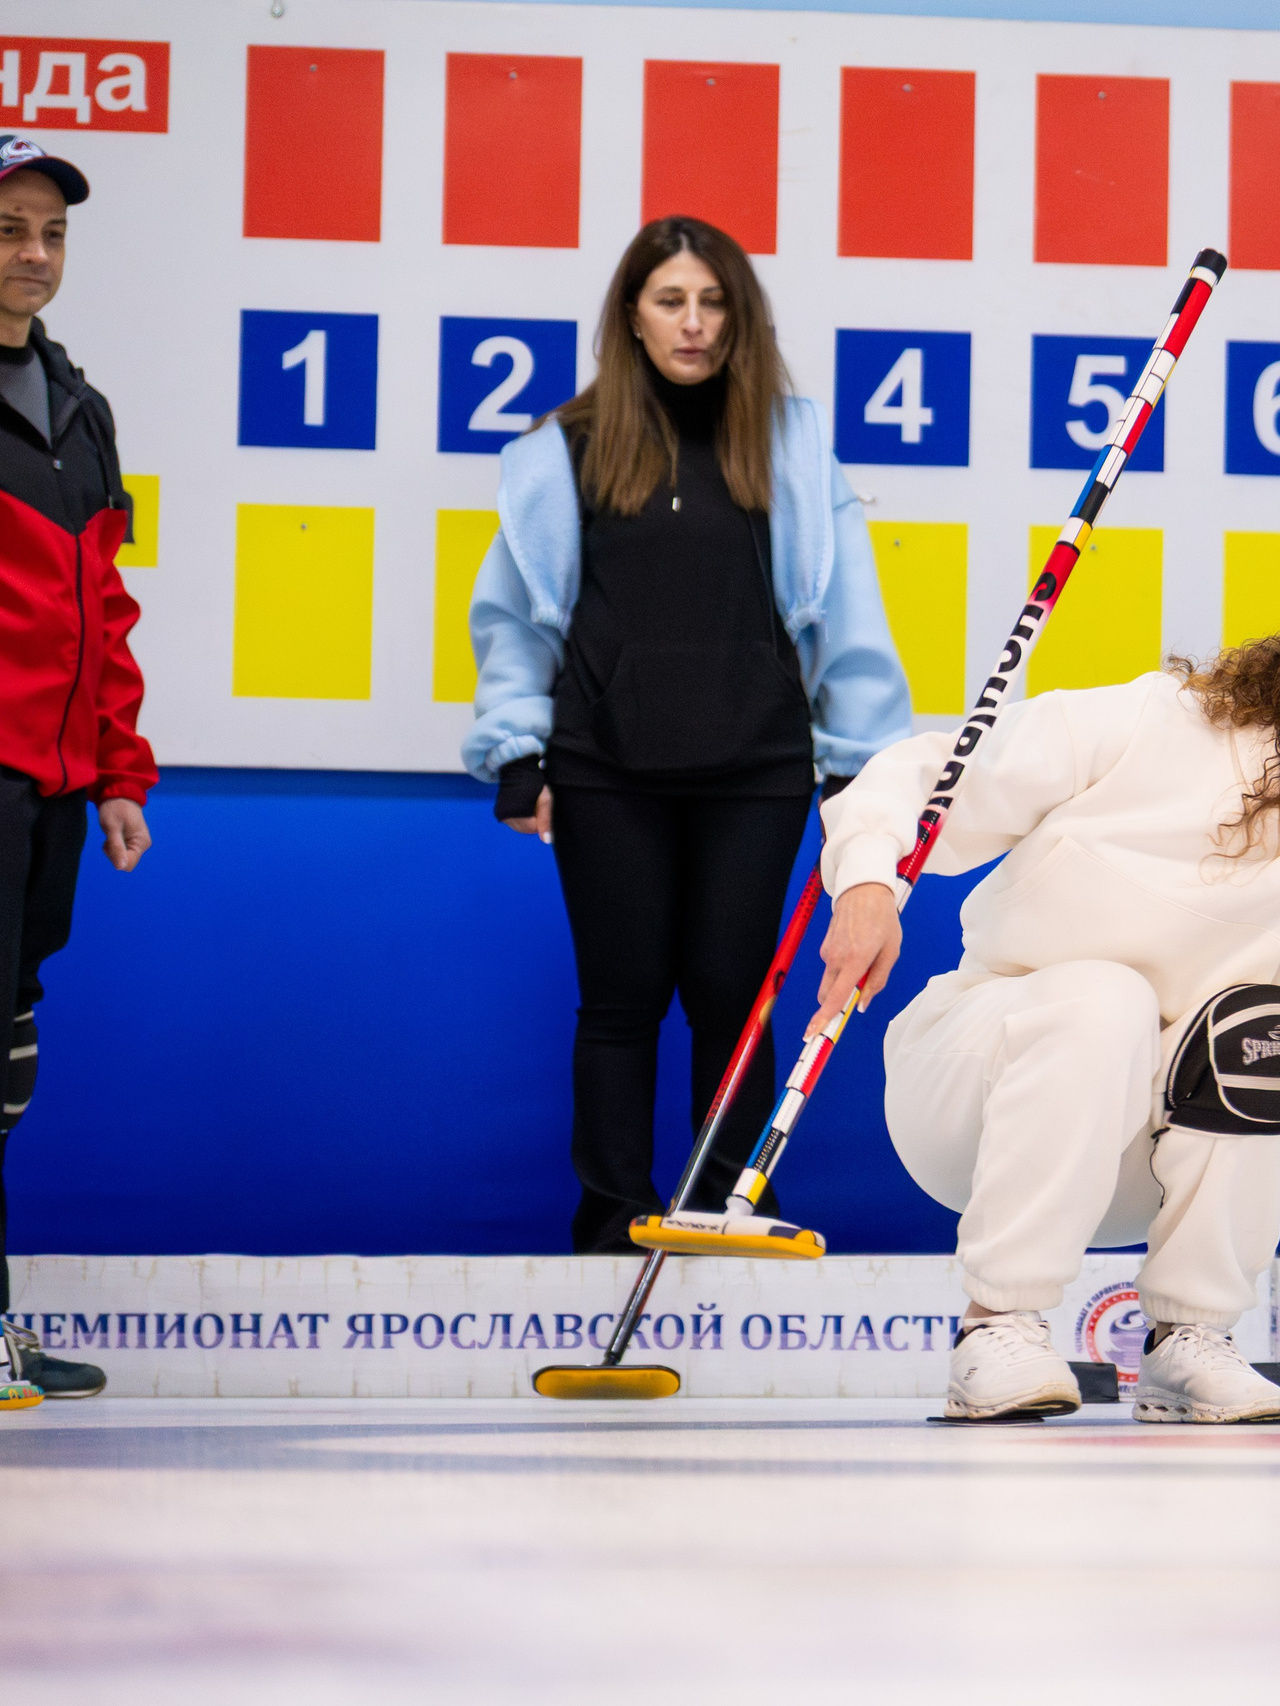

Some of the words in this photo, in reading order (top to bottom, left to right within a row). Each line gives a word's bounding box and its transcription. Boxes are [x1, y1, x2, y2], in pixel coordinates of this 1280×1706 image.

[281, 329, 327, 427] 1
[467, 335, 535, 433] 2
[863, 347, 934, 444] 4
[1064, 353, 1128, 451] 5
